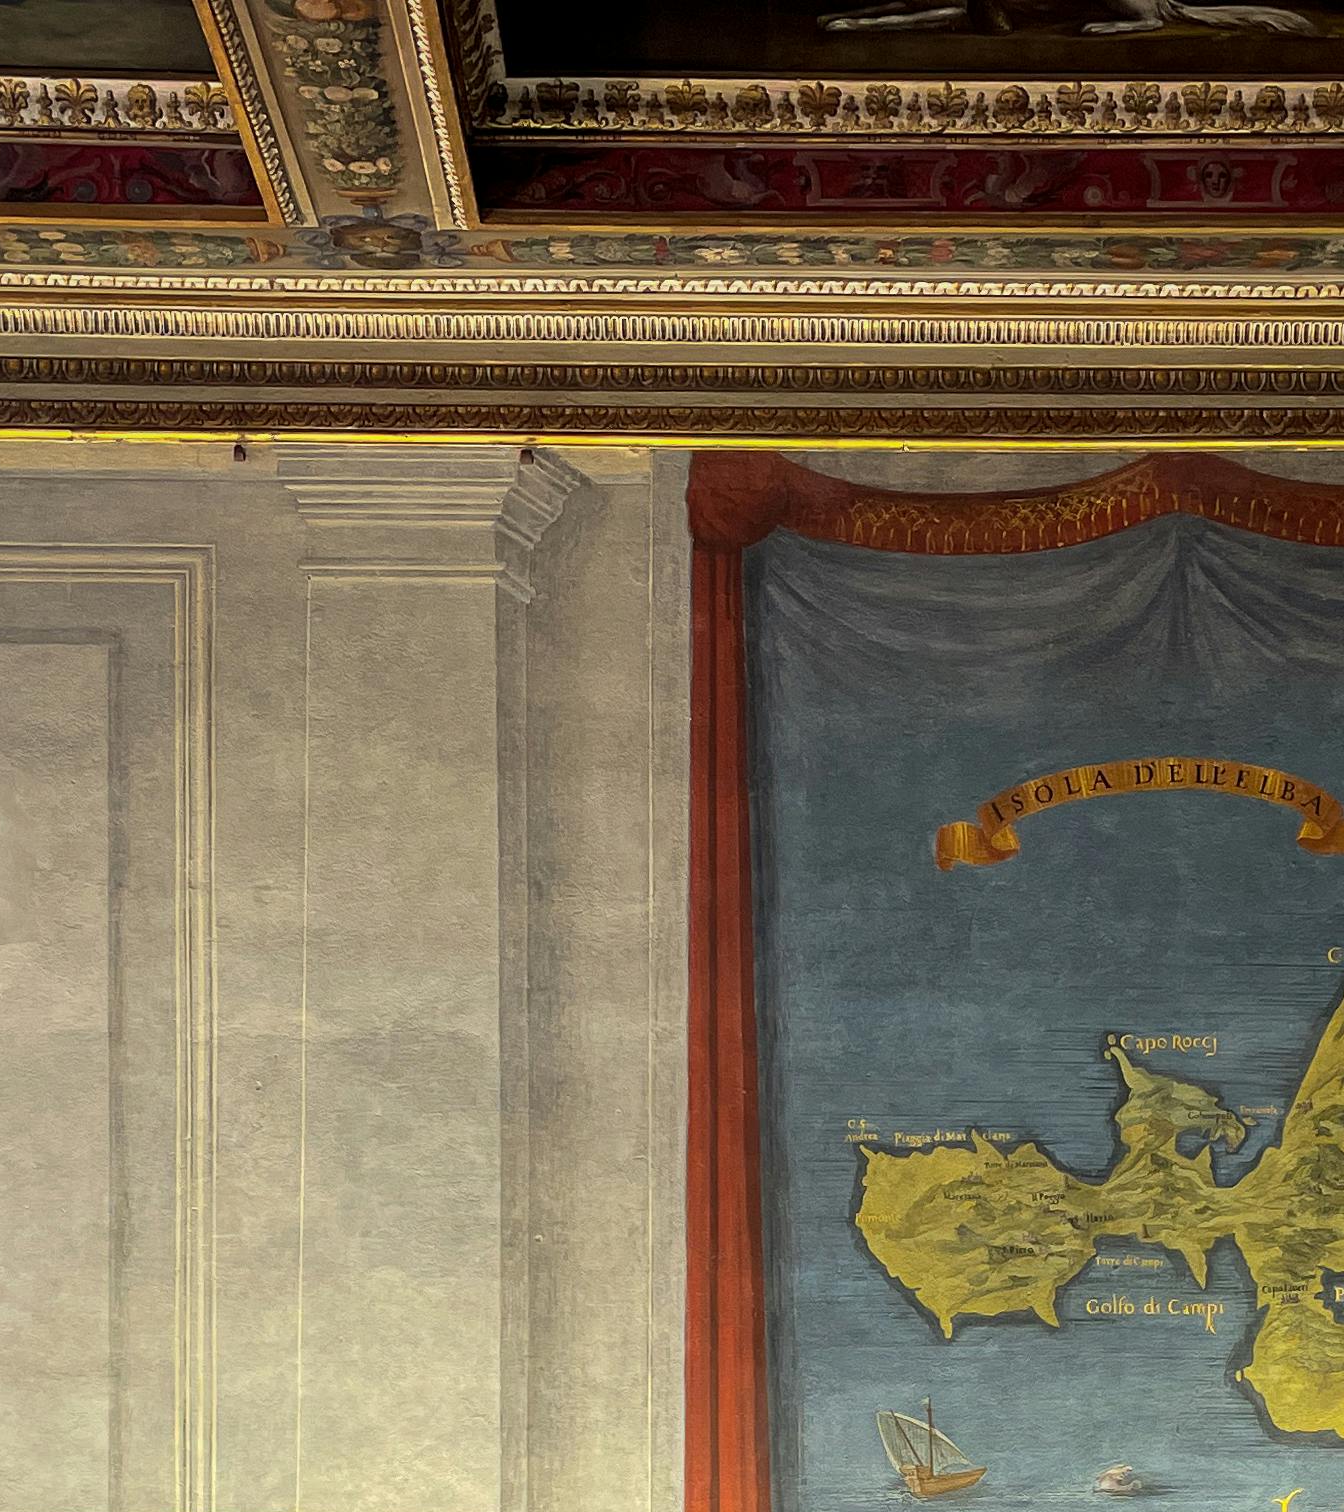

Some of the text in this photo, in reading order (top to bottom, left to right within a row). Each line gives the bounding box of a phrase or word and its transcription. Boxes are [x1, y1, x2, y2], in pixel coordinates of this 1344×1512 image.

[990, 768, 1113, 823] ISOLA
[1120, 1034, 1167, 1055] Capo
[1086, 1294, 1224, 1334] Golfo di Campi
